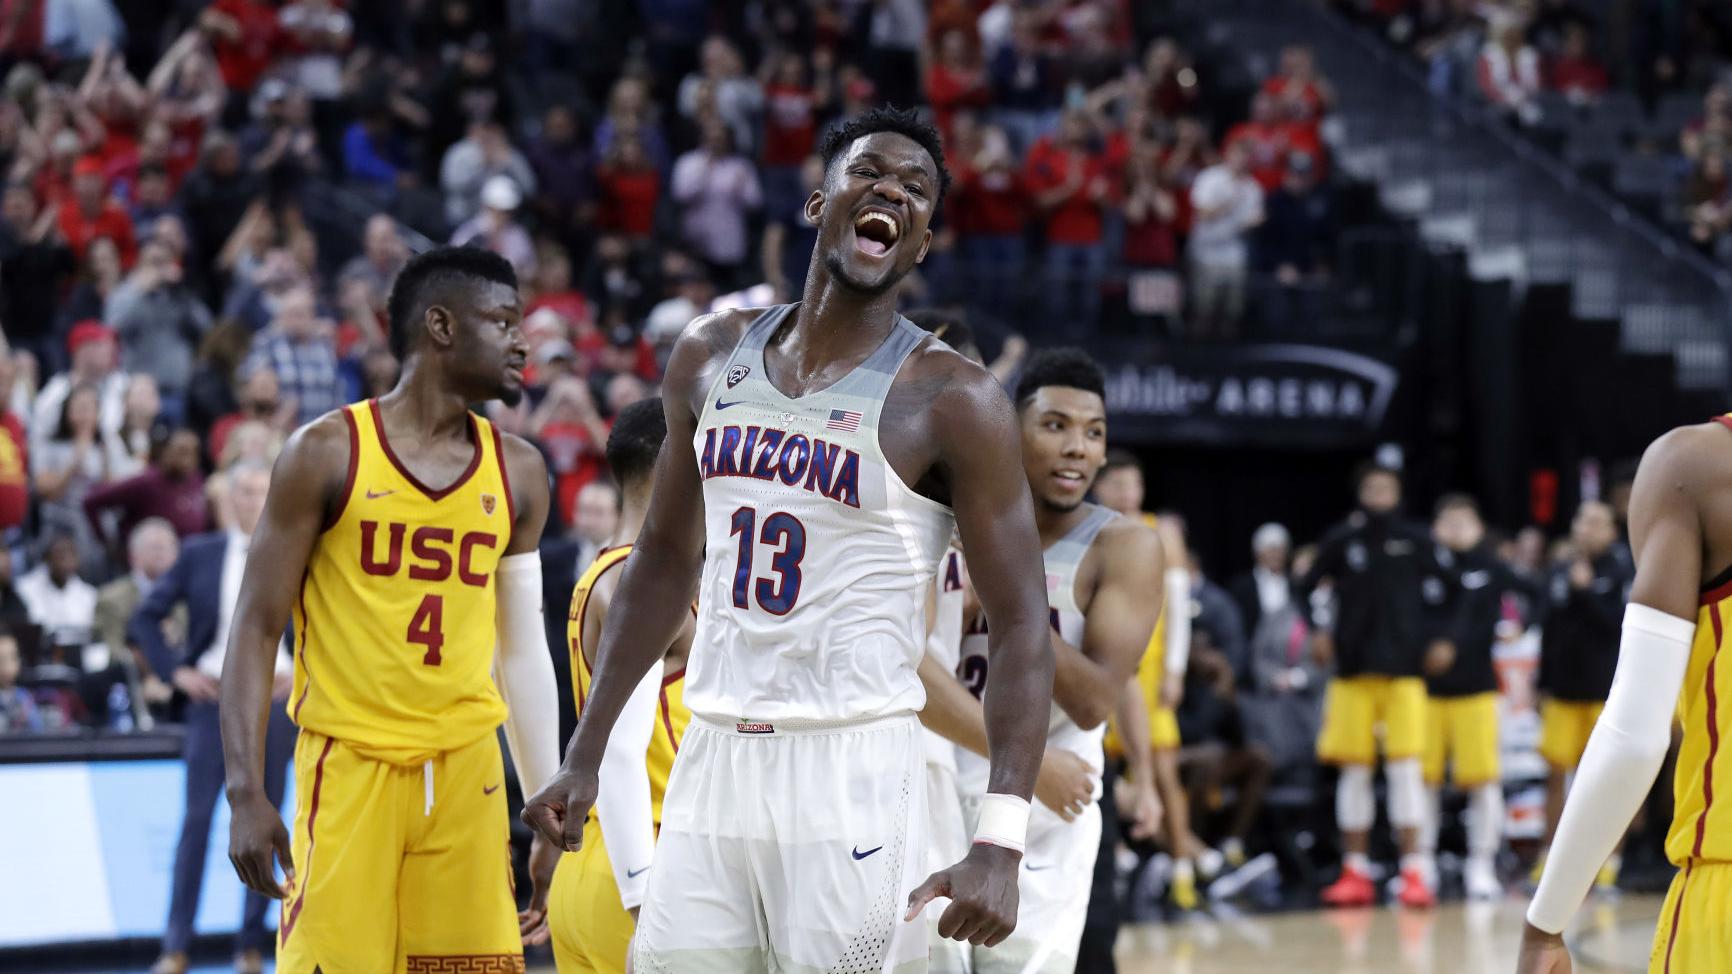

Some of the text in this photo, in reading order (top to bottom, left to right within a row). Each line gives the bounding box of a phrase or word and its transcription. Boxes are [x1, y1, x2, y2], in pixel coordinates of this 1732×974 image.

[1216, 376, 1364, 417] ARENA
[701, 425, 861, 509] ARIZONA
[360, 520, 498, 588] USC
[730, 506, 806, 616] 13
[406, 593, 444, 666] 4
[736, 723, 773, 732] ARIZONA
